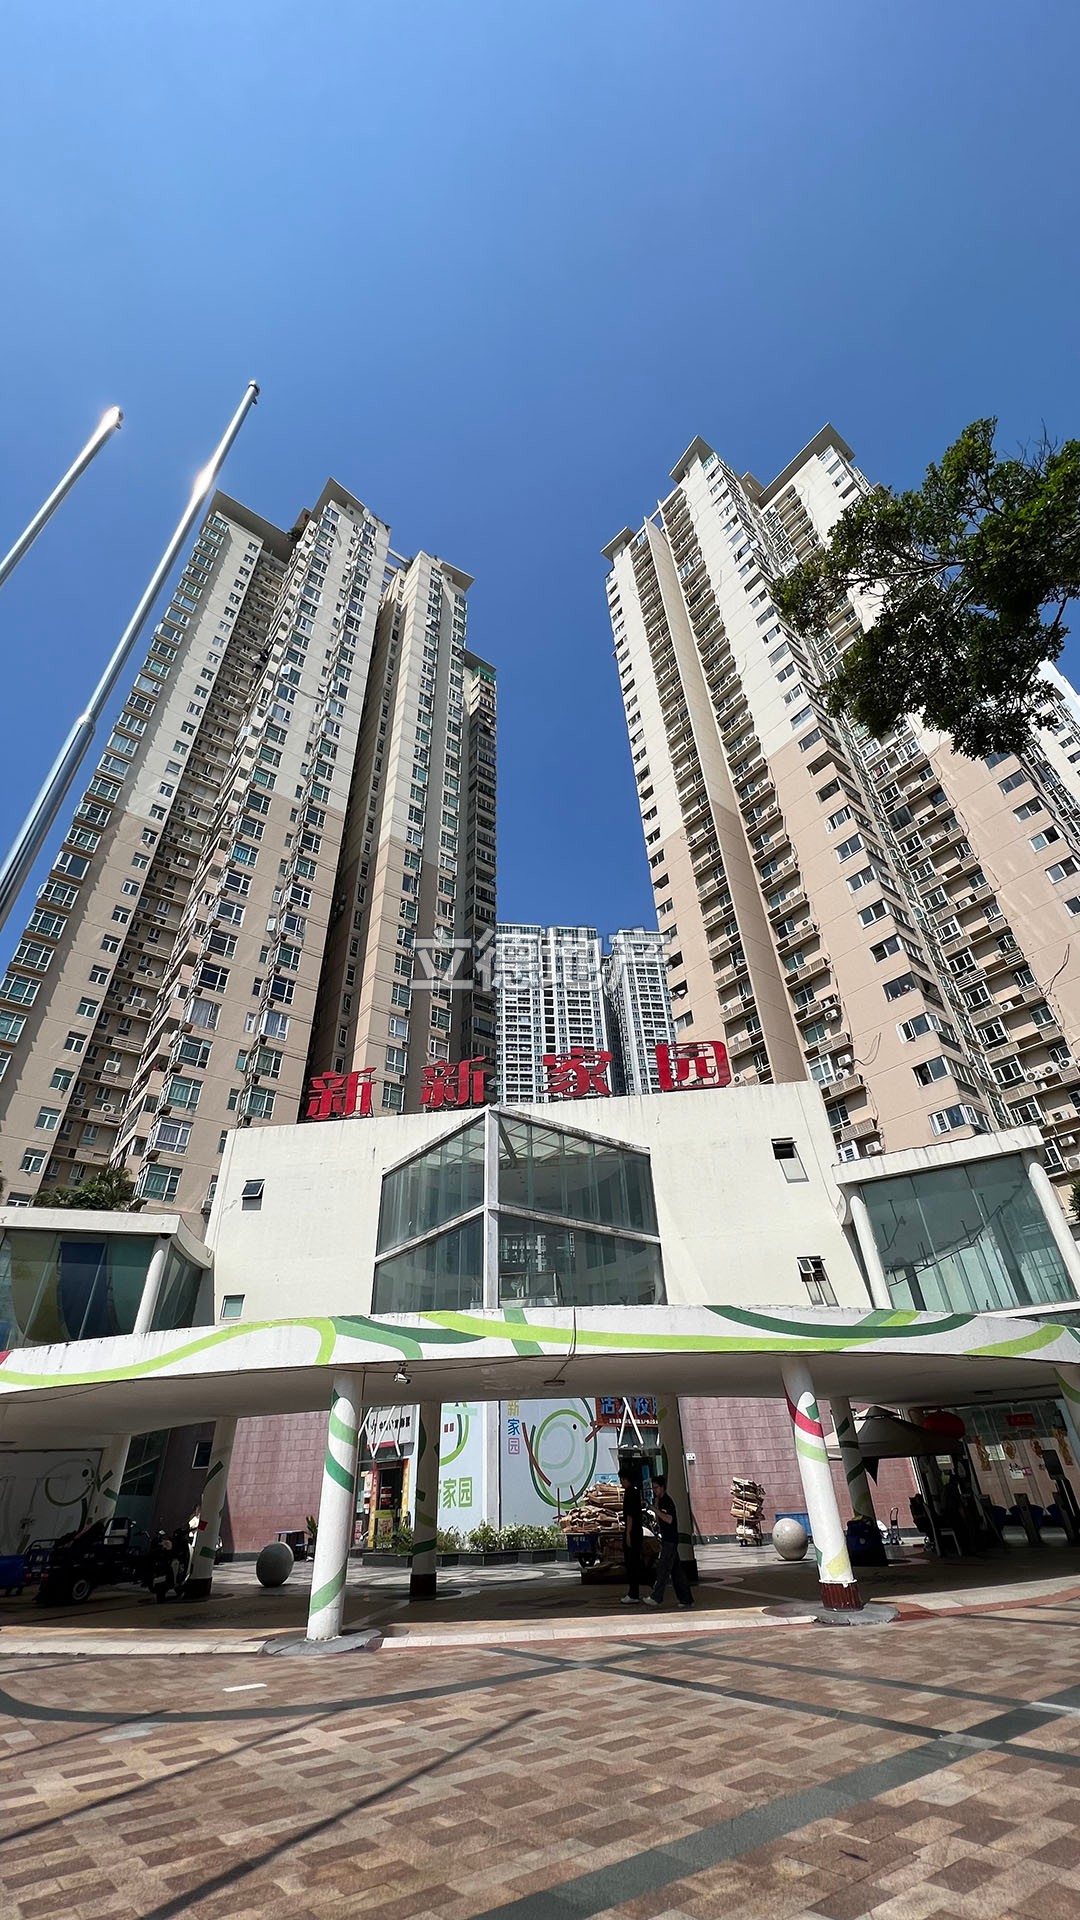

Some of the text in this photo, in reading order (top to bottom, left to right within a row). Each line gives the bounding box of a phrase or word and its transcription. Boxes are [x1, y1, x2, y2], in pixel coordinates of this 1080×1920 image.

[306, 1040, 731, 1119] 新新家园
[438, 1476, 473, 1510] 家园
